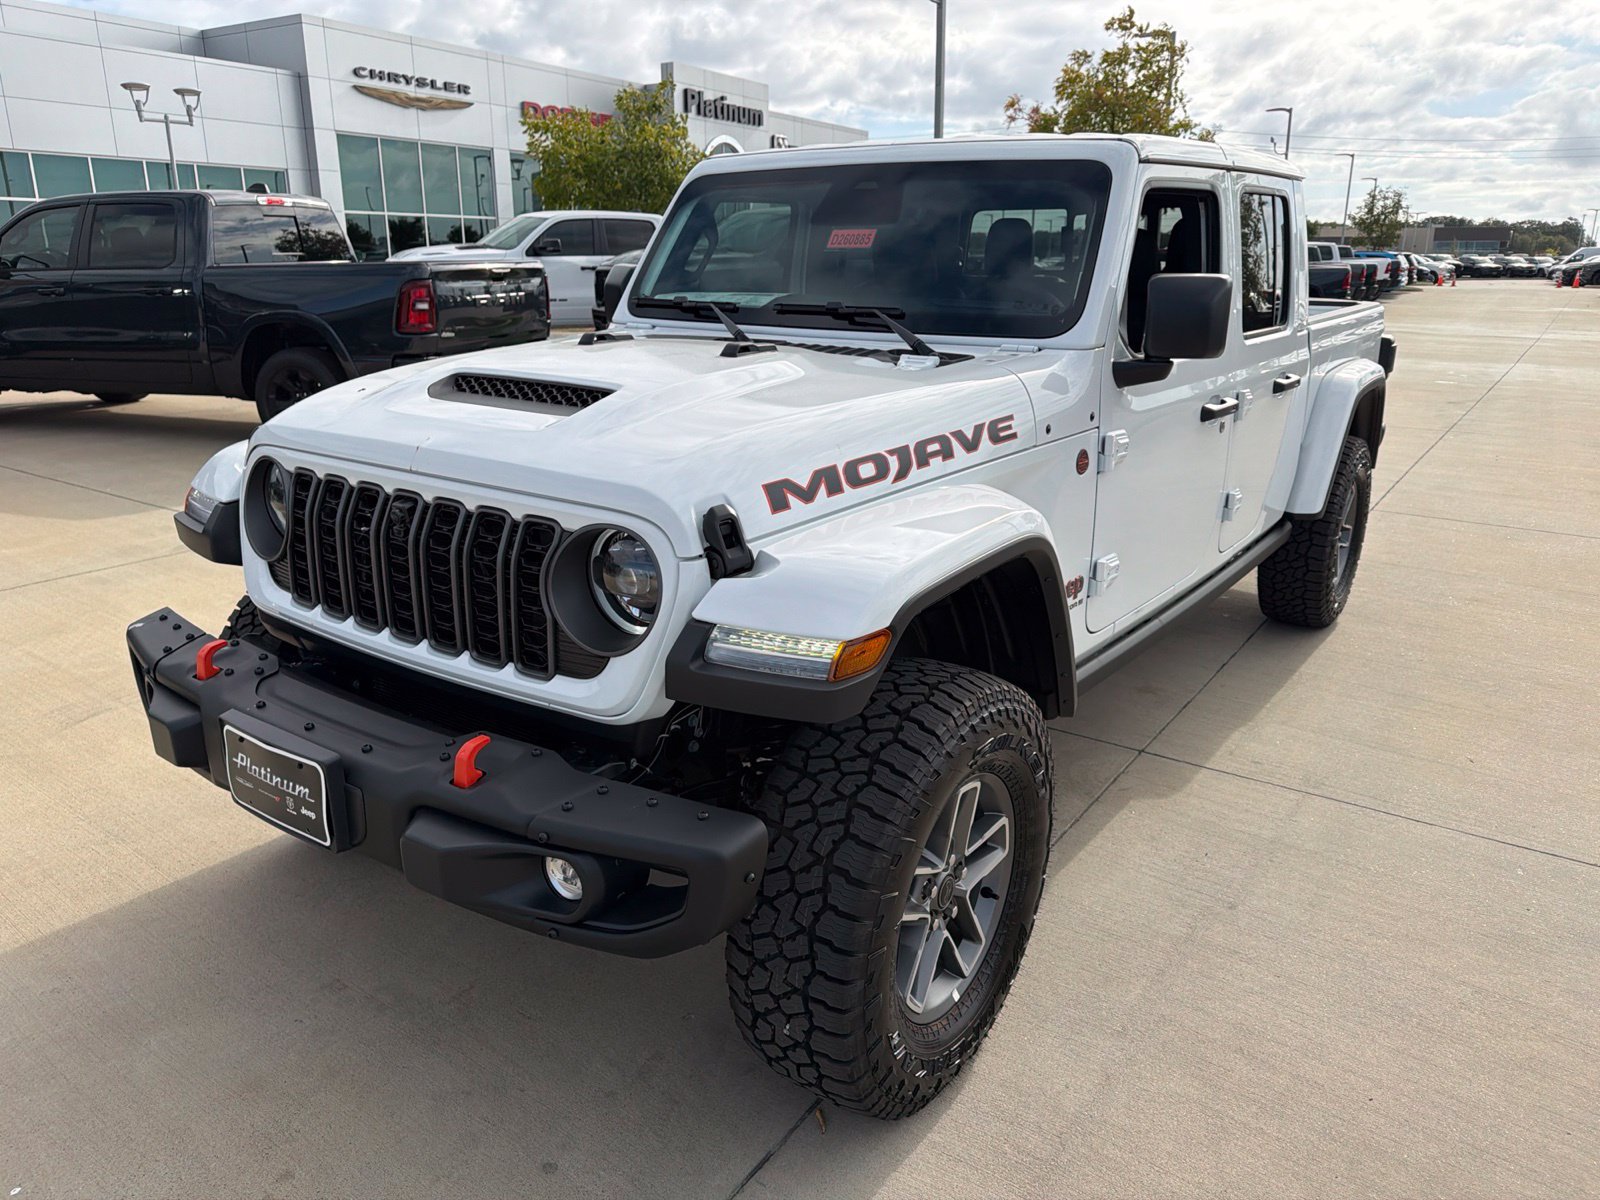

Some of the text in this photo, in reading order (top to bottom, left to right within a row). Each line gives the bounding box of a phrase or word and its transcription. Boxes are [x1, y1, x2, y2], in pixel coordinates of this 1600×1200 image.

[353, 66, 471, 95] CHRYSLER
[683, 88, 764, 127] Platinum
[830, 233, 873, 246] D260885
[761, 414, 1018, 515] MOJAVE
[232, 752, 315, 803] Platinum
